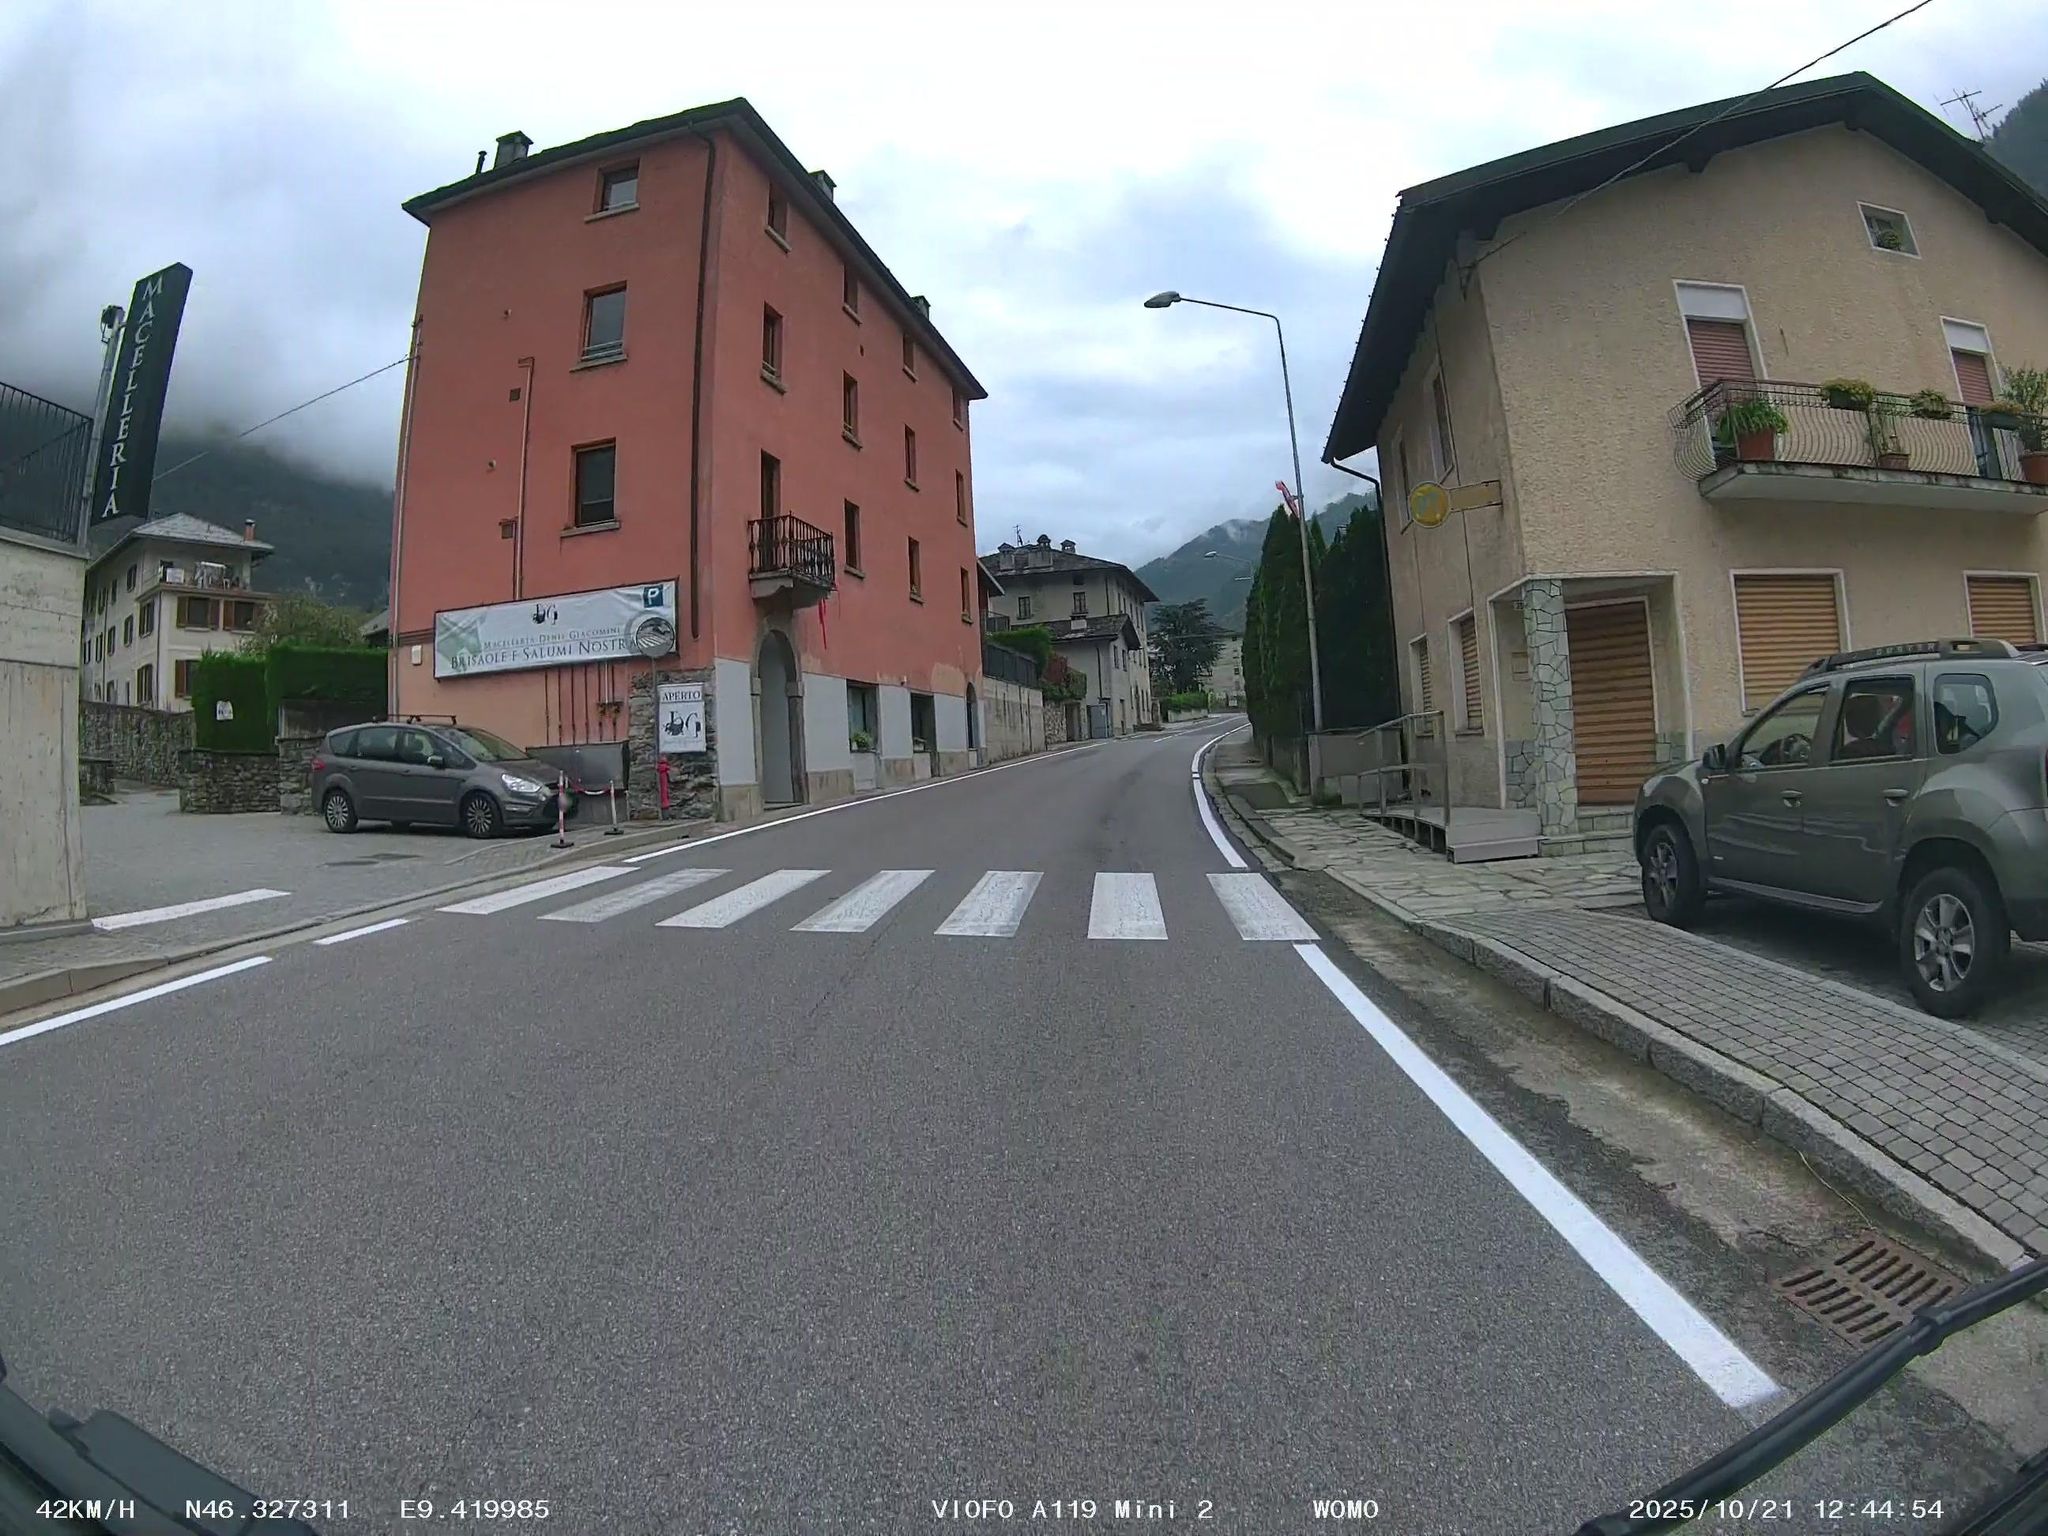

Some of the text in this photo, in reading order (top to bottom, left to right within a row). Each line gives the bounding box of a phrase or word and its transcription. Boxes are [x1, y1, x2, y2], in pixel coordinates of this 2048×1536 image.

[101, 274, 163, 518] MACELLERIA
[648, 587, 659, 605] P
[523, 644, 572, 661] SALUMI
[662, 690, 701, 701] APERTO
